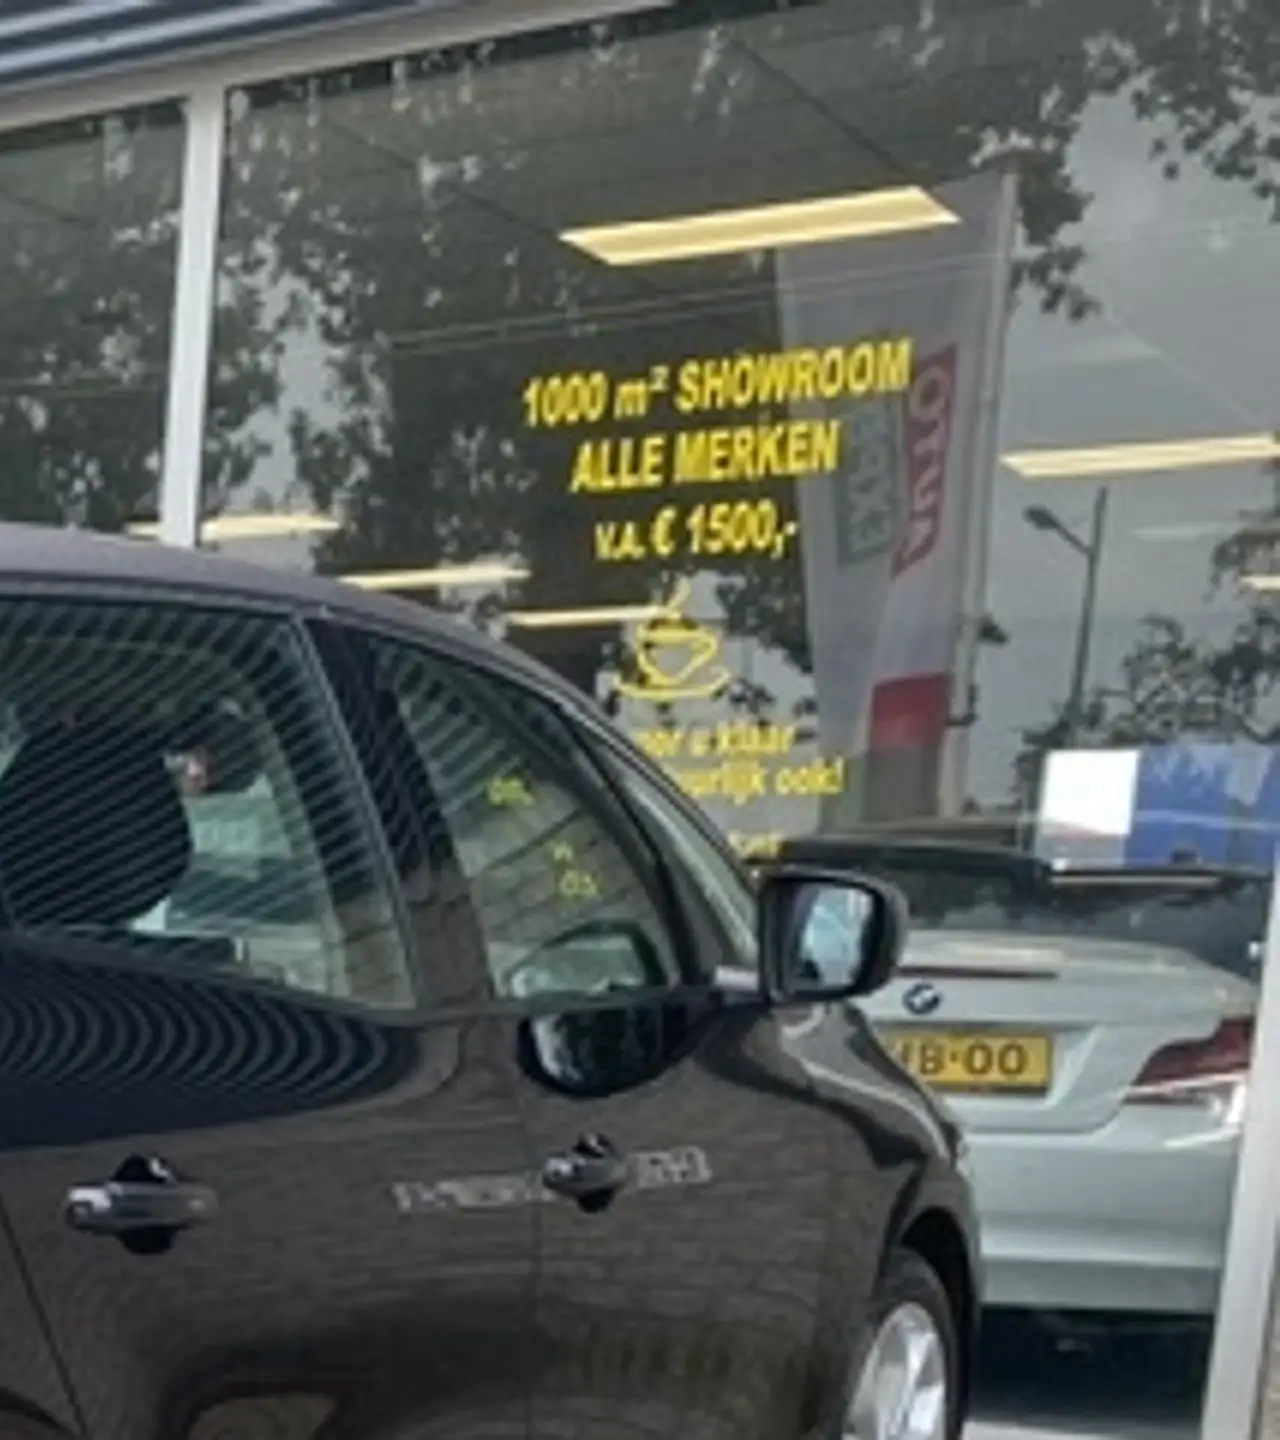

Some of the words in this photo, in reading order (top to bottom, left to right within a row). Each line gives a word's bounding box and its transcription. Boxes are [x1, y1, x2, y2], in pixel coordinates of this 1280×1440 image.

[523, 371, 608, 428] 1000
[676, 338, 912, 412] SHOWROOM
[570, 433, 665, 493] ALLE
[674, 418, 842, 484] MERKEN
[650, 505, 677, 558] €
[685, 498, 800, 560] 1500,-
